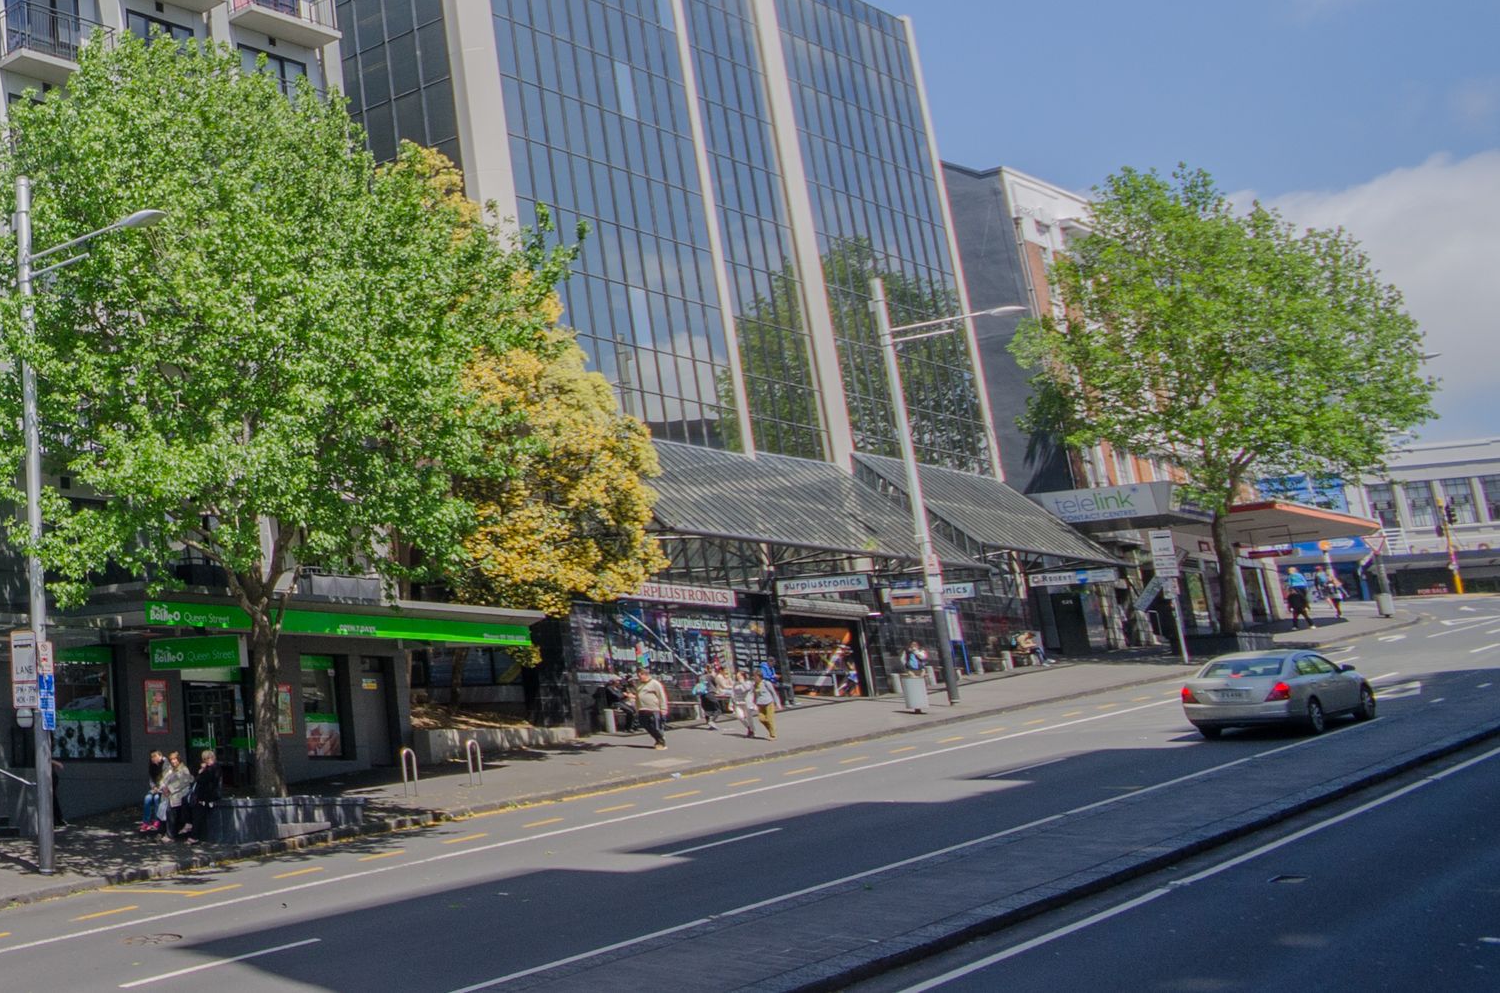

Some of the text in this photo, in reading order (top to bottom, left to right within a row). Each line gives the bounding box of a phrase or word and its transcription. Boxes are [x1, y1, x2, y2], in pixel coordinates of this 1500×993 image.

[1055, 490, 1134, 514] telelink
[1062, 509, 1138, 522] CONTACT CENTRES
[784, 575, 863, 591] surplustronics
[183, 611, 208, 624] Queen
[208, 614, 230, 624] Street
[187, 650, 211, 662] Queen
[212, 649, 236, 660] Street
[15, 665, 33, 675] LANE
